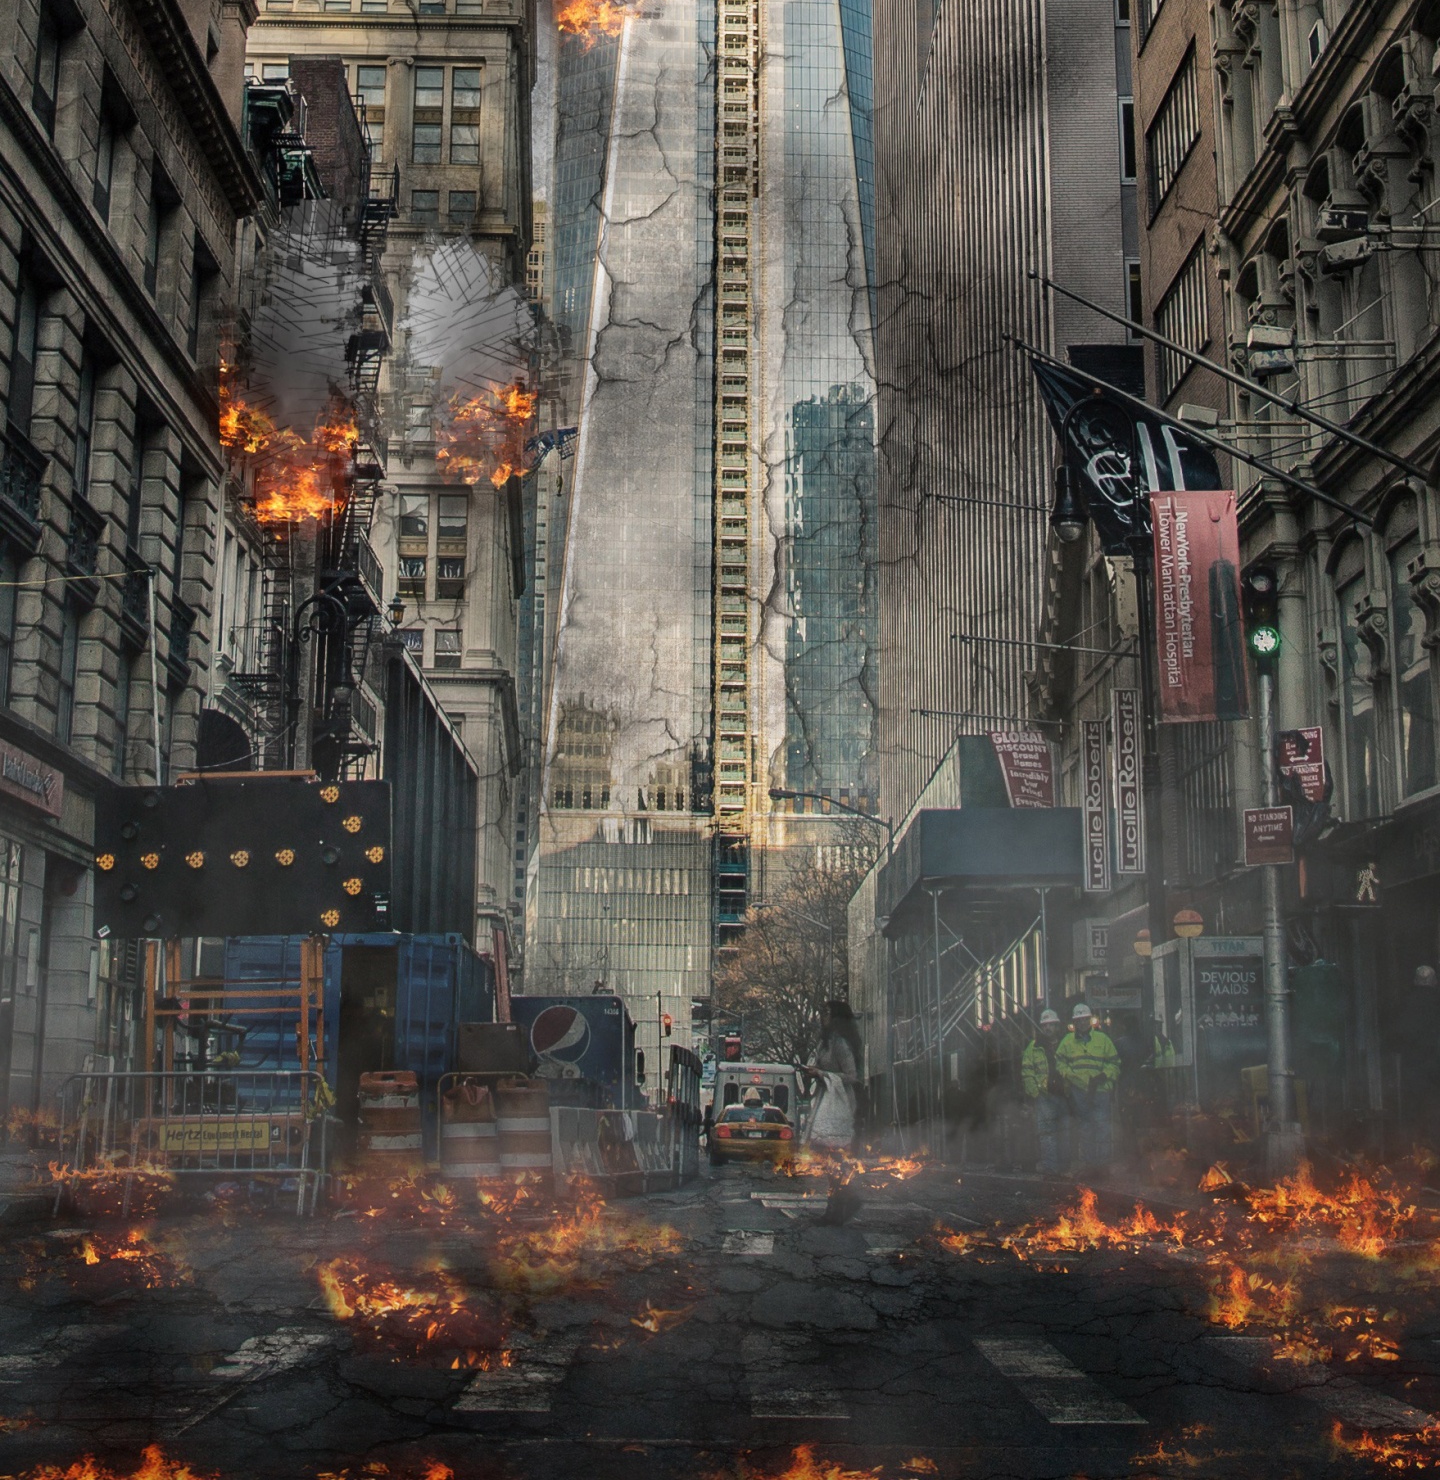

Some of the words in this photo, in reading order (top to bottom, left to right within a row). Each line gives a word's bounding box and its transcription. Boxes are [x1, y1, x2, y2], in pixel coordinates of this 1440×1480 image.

[1158, 508, 1171, 554] Lower
[1161, 554, 1176, 629] Manhattan
[1175, 511, 1194, 658] NewYork-Presbyterian
[1163, 632, 1182, 688] Hospital
[991, 732, 1045, 745] GLOBAL
[995, 744, 1047, 753] DISCOUNT
[1119, 691, 1135, 787] Roberts
[1010, 770, 1049, 783] Incredibly
[1086, 723, 1101, 811] Roberts
[1124, 791, 1137, 870] Lucille
[1248, 815, 1256, 823] NO
[1259, 812, 1288, 822] STANDING
[1253, 823, 1284, 833] ANYTIME
[1090, 815, 1103, 889] Lucille
[1200, 971, 1256, 984] DEVIOUS
[1209, 983, 1249, 996] MAIDS
[167, 1129, 201, 1141] Hertz
